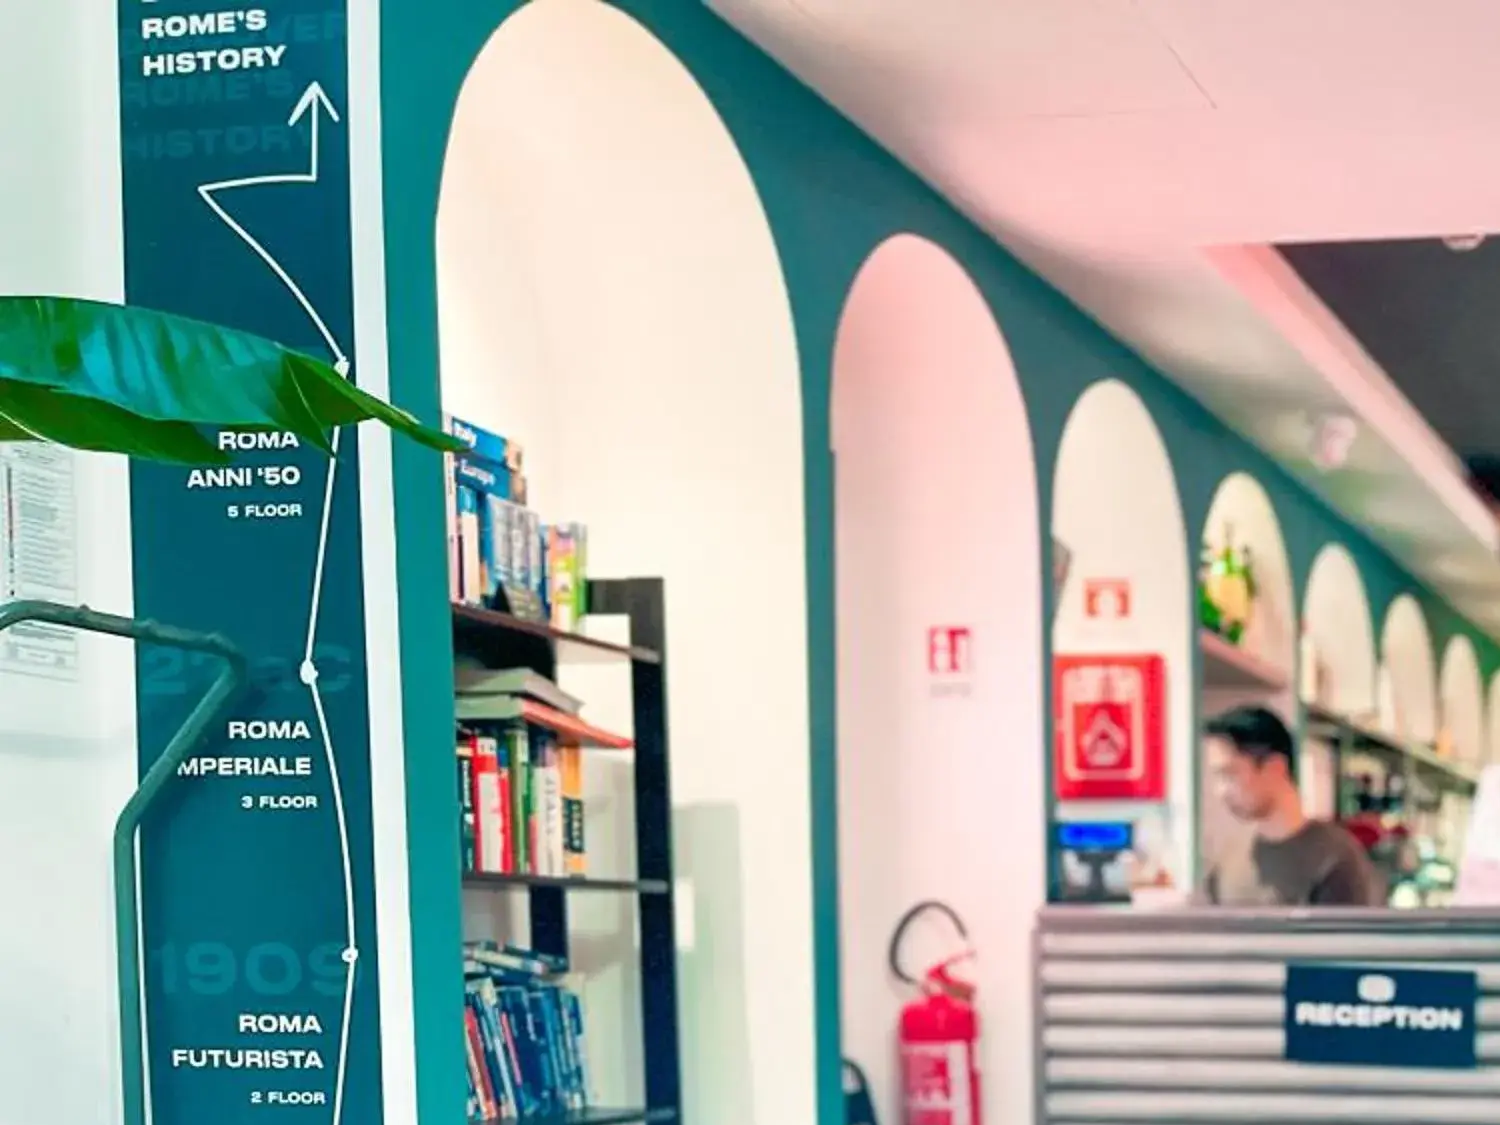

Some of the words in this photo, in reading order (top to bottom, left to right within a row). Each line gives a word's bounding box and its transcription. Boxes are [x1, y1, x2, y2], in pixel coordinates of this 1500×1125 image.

[141, 10, 267, 38] ROME'S
[143, 45, 286, 76] HISTORY
[218, 431, 300, 450] ROMA
[187, 467, 253, 488] ANNI
[227, 505, 239, 518] 5
[245, 503, 302, 517] FLOOR
[228, 720, 311, 739] ROMA
[177, 757, 312, 776] MPERIALE
[241, 795, 253, 809] 3
[259, 795, 318, 809] FLOOR
[239, 1014, 322, 1033] ROMA
[1296, 1001, 1463, 1030] RECEPTION
[172, 1049, 324, 1069] FUTURISTA
[251, 1091, 262, 1104] 2
[267, 1091, 326, 1105] FLOOR
